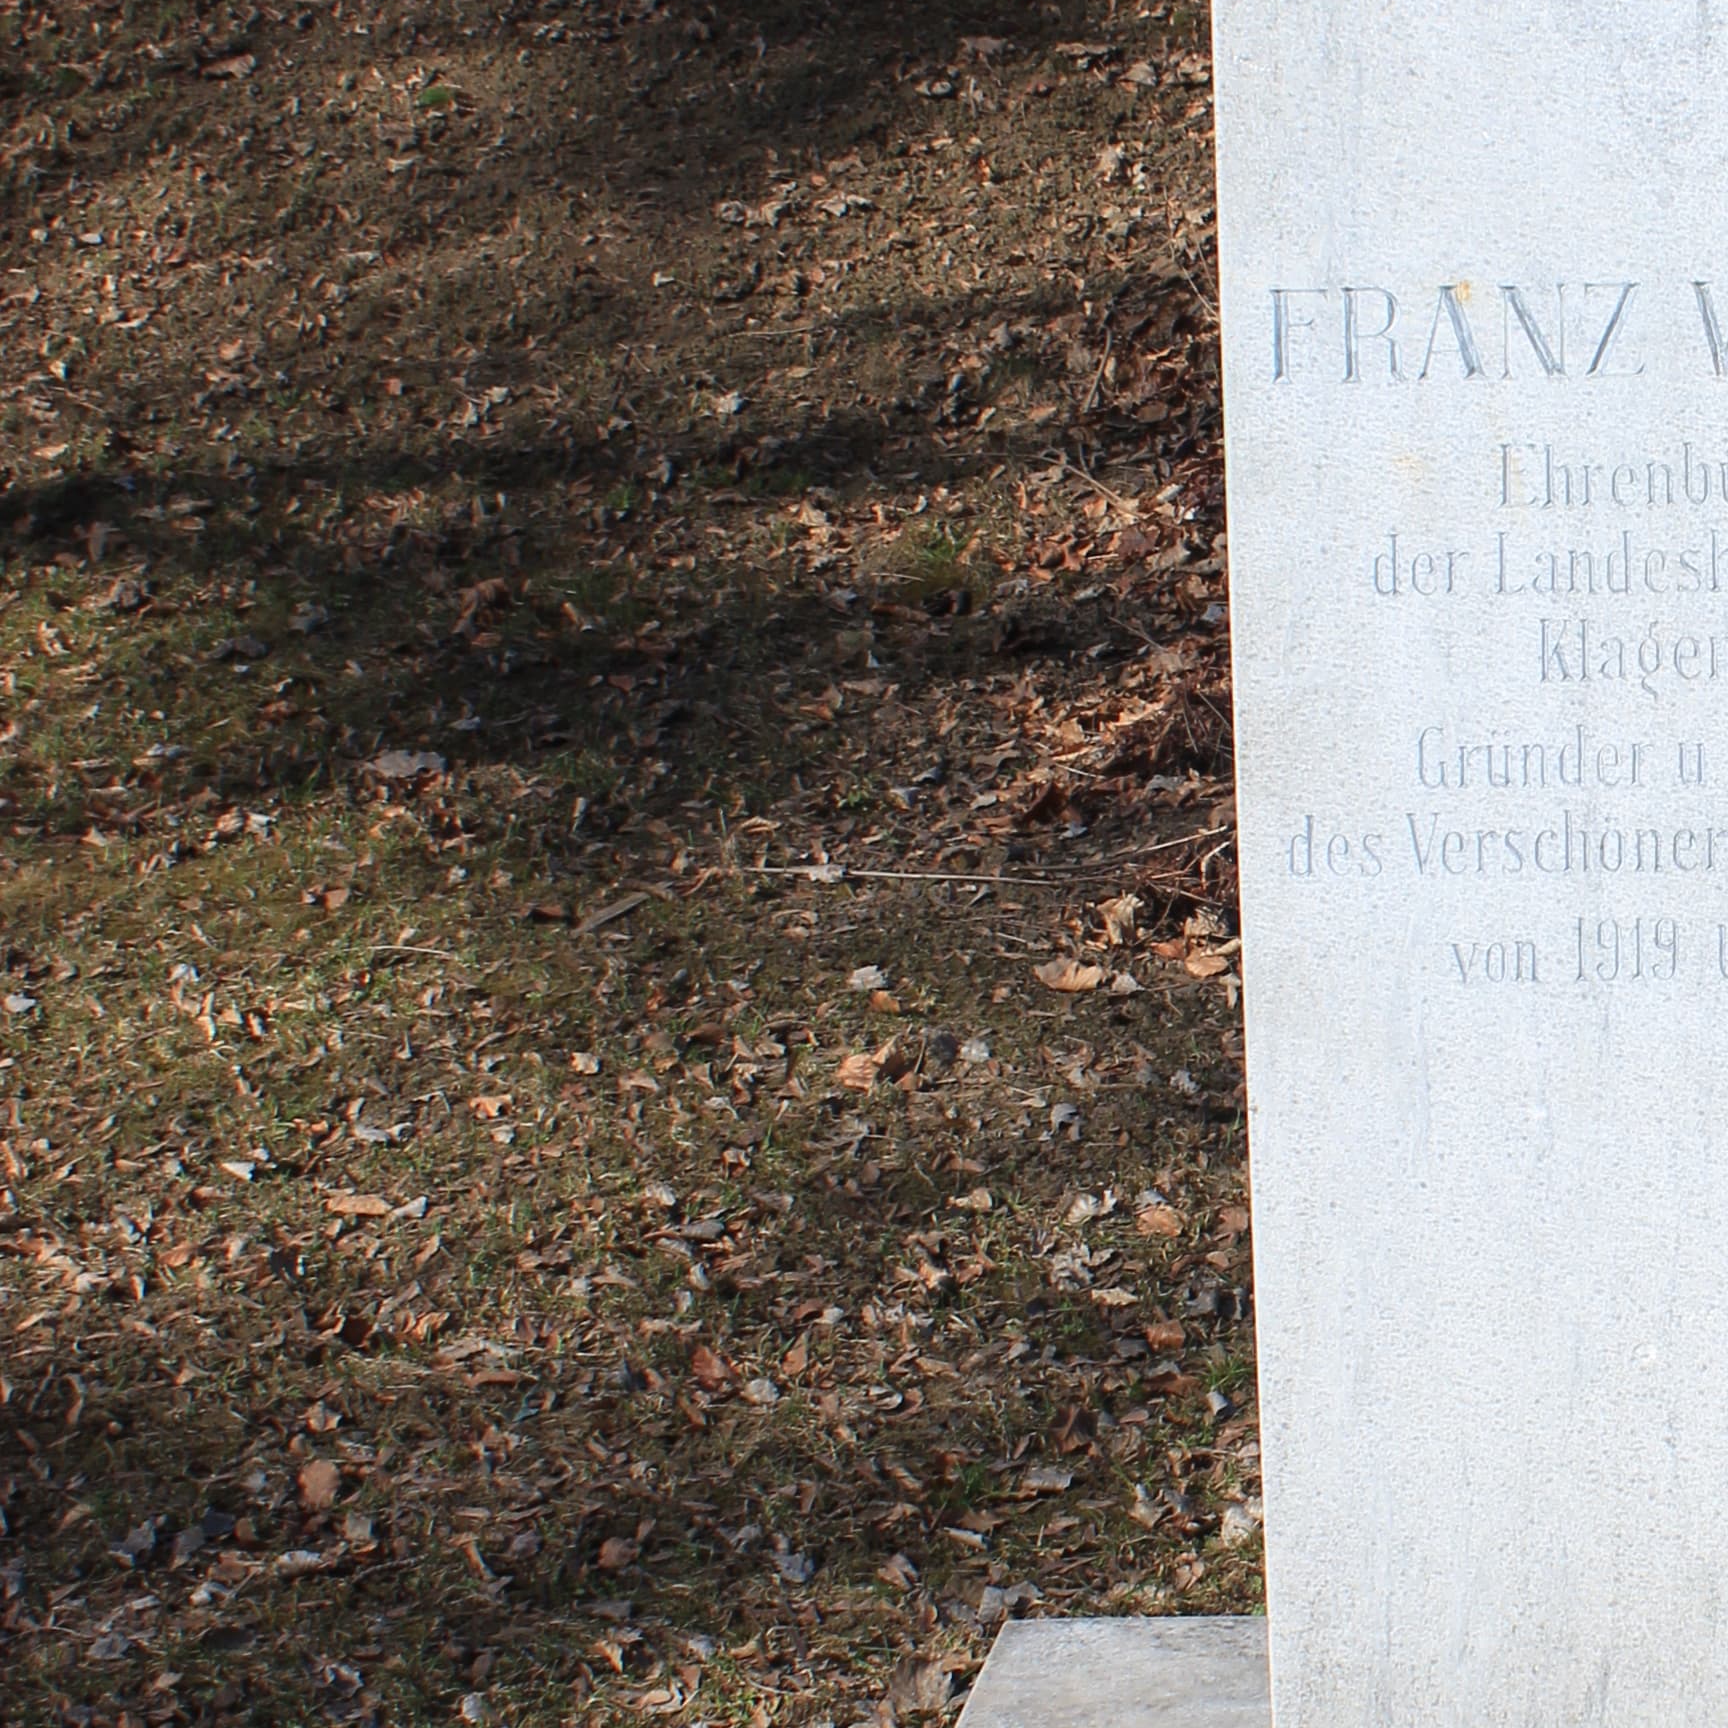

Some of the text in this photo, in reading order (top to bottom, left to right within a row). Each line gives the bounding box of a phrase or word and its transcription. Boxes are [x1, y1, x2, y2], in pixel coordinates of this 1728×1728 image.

[1269, 280, 1646, 385] FRANZ
[1372, 531, 1471, 597] der
[1416, 722, 1655, 790] Gründer
[1287, 813, 1385, 878] des
[1450, 939, 1541, 985] von
[1574, 915, 1680, 983] 1919
